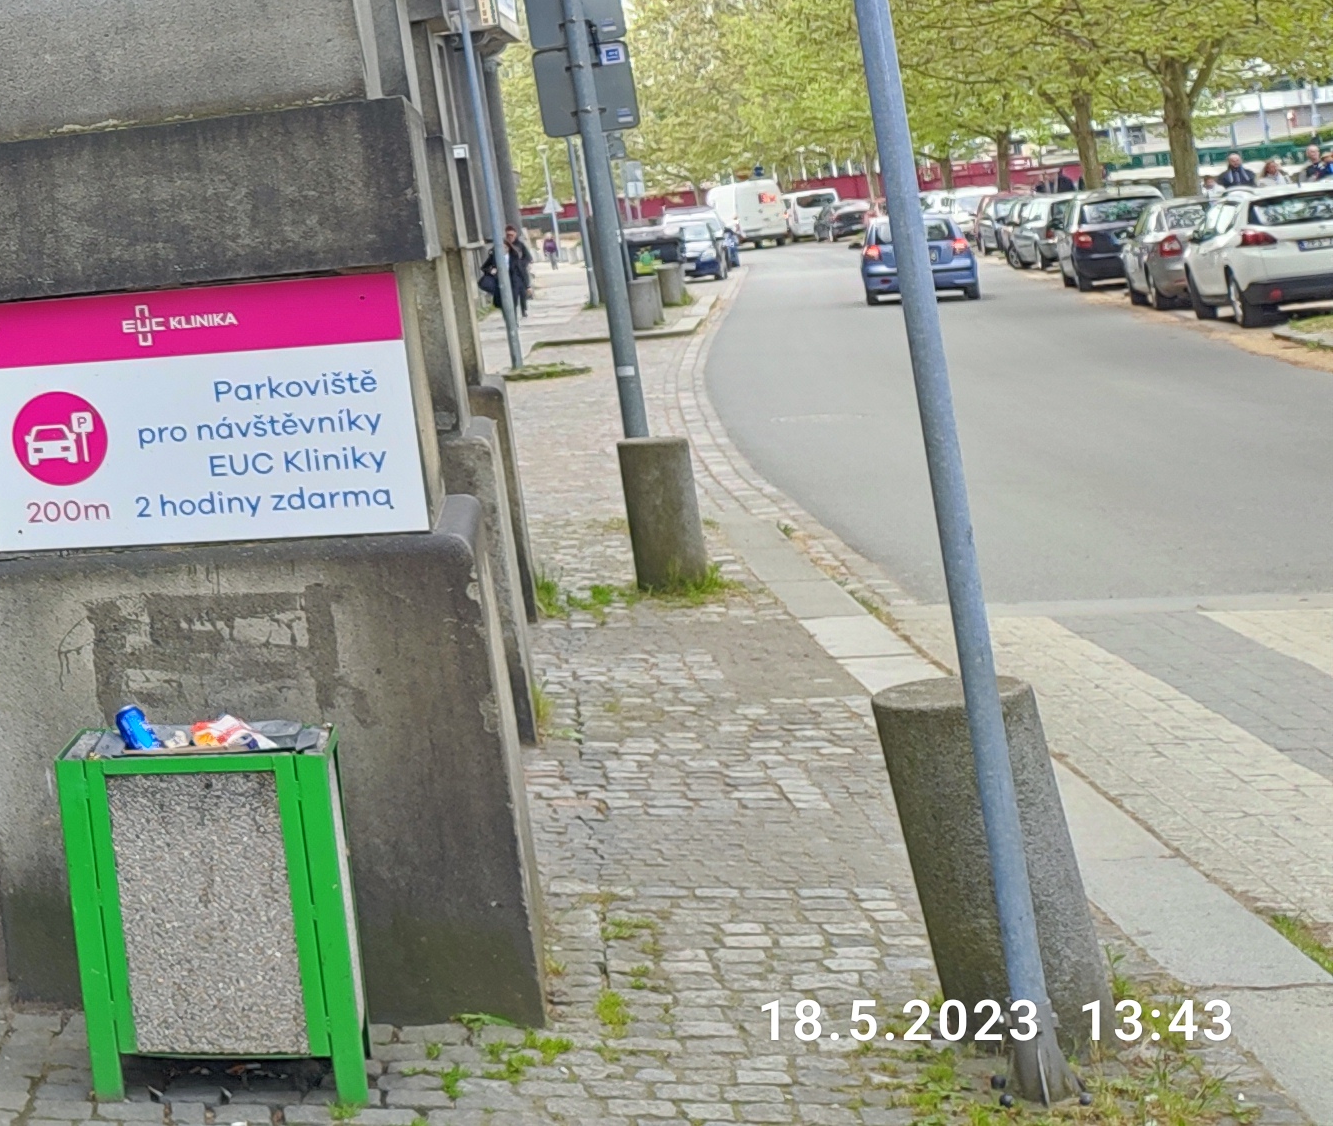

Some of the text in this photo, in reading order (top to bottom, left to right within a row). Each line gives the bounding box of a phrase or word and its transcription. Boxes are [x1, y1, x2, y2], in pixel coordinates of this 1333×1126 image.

[169, 312, 238, 329] KLINIKA
[213, 369, 378, 403] Parkoviště
[137, 408, 382, 449] pro návštěvníky
[209, 446, 387, 477] EUC Kliniky
[26, 500, 111, 523] 200m
[135, 486, 392, 518] 2 hodiny zdarma
